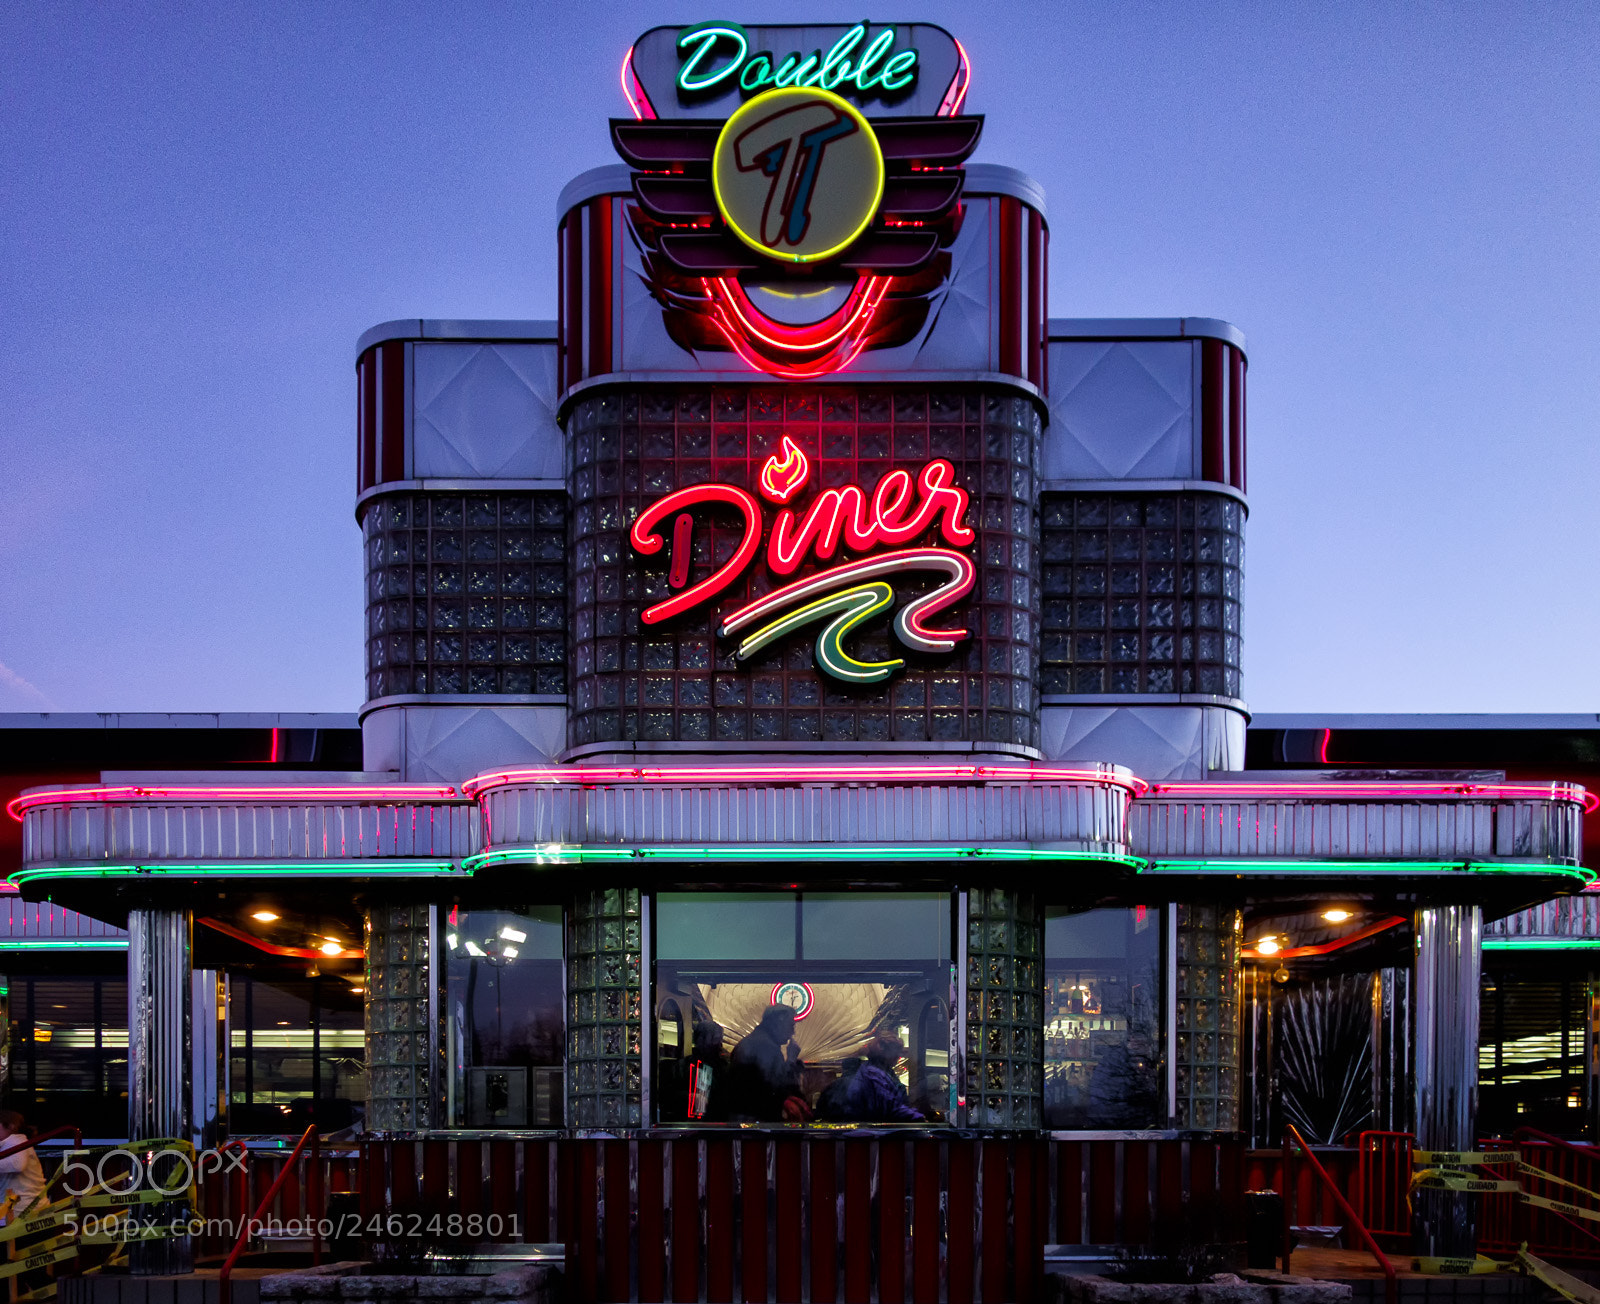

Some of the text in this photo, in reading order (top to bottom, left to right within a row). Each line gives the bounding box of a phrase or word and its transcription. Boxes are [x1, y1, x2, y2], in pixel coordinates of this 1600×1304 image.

[676, 22, 919, 91] Double
[630, 434, 976, 625] Diner
[1431, 1153, 1514, 1163] CAUTION CUIDADO
[1466, 1181, 1498, 1191] CUIDADO
[110, 1193, 140, 1204] CAUTION
[25, 1216, 57, 1233] CAUTION
[25, 1252, 57, 1269] CAUTION
